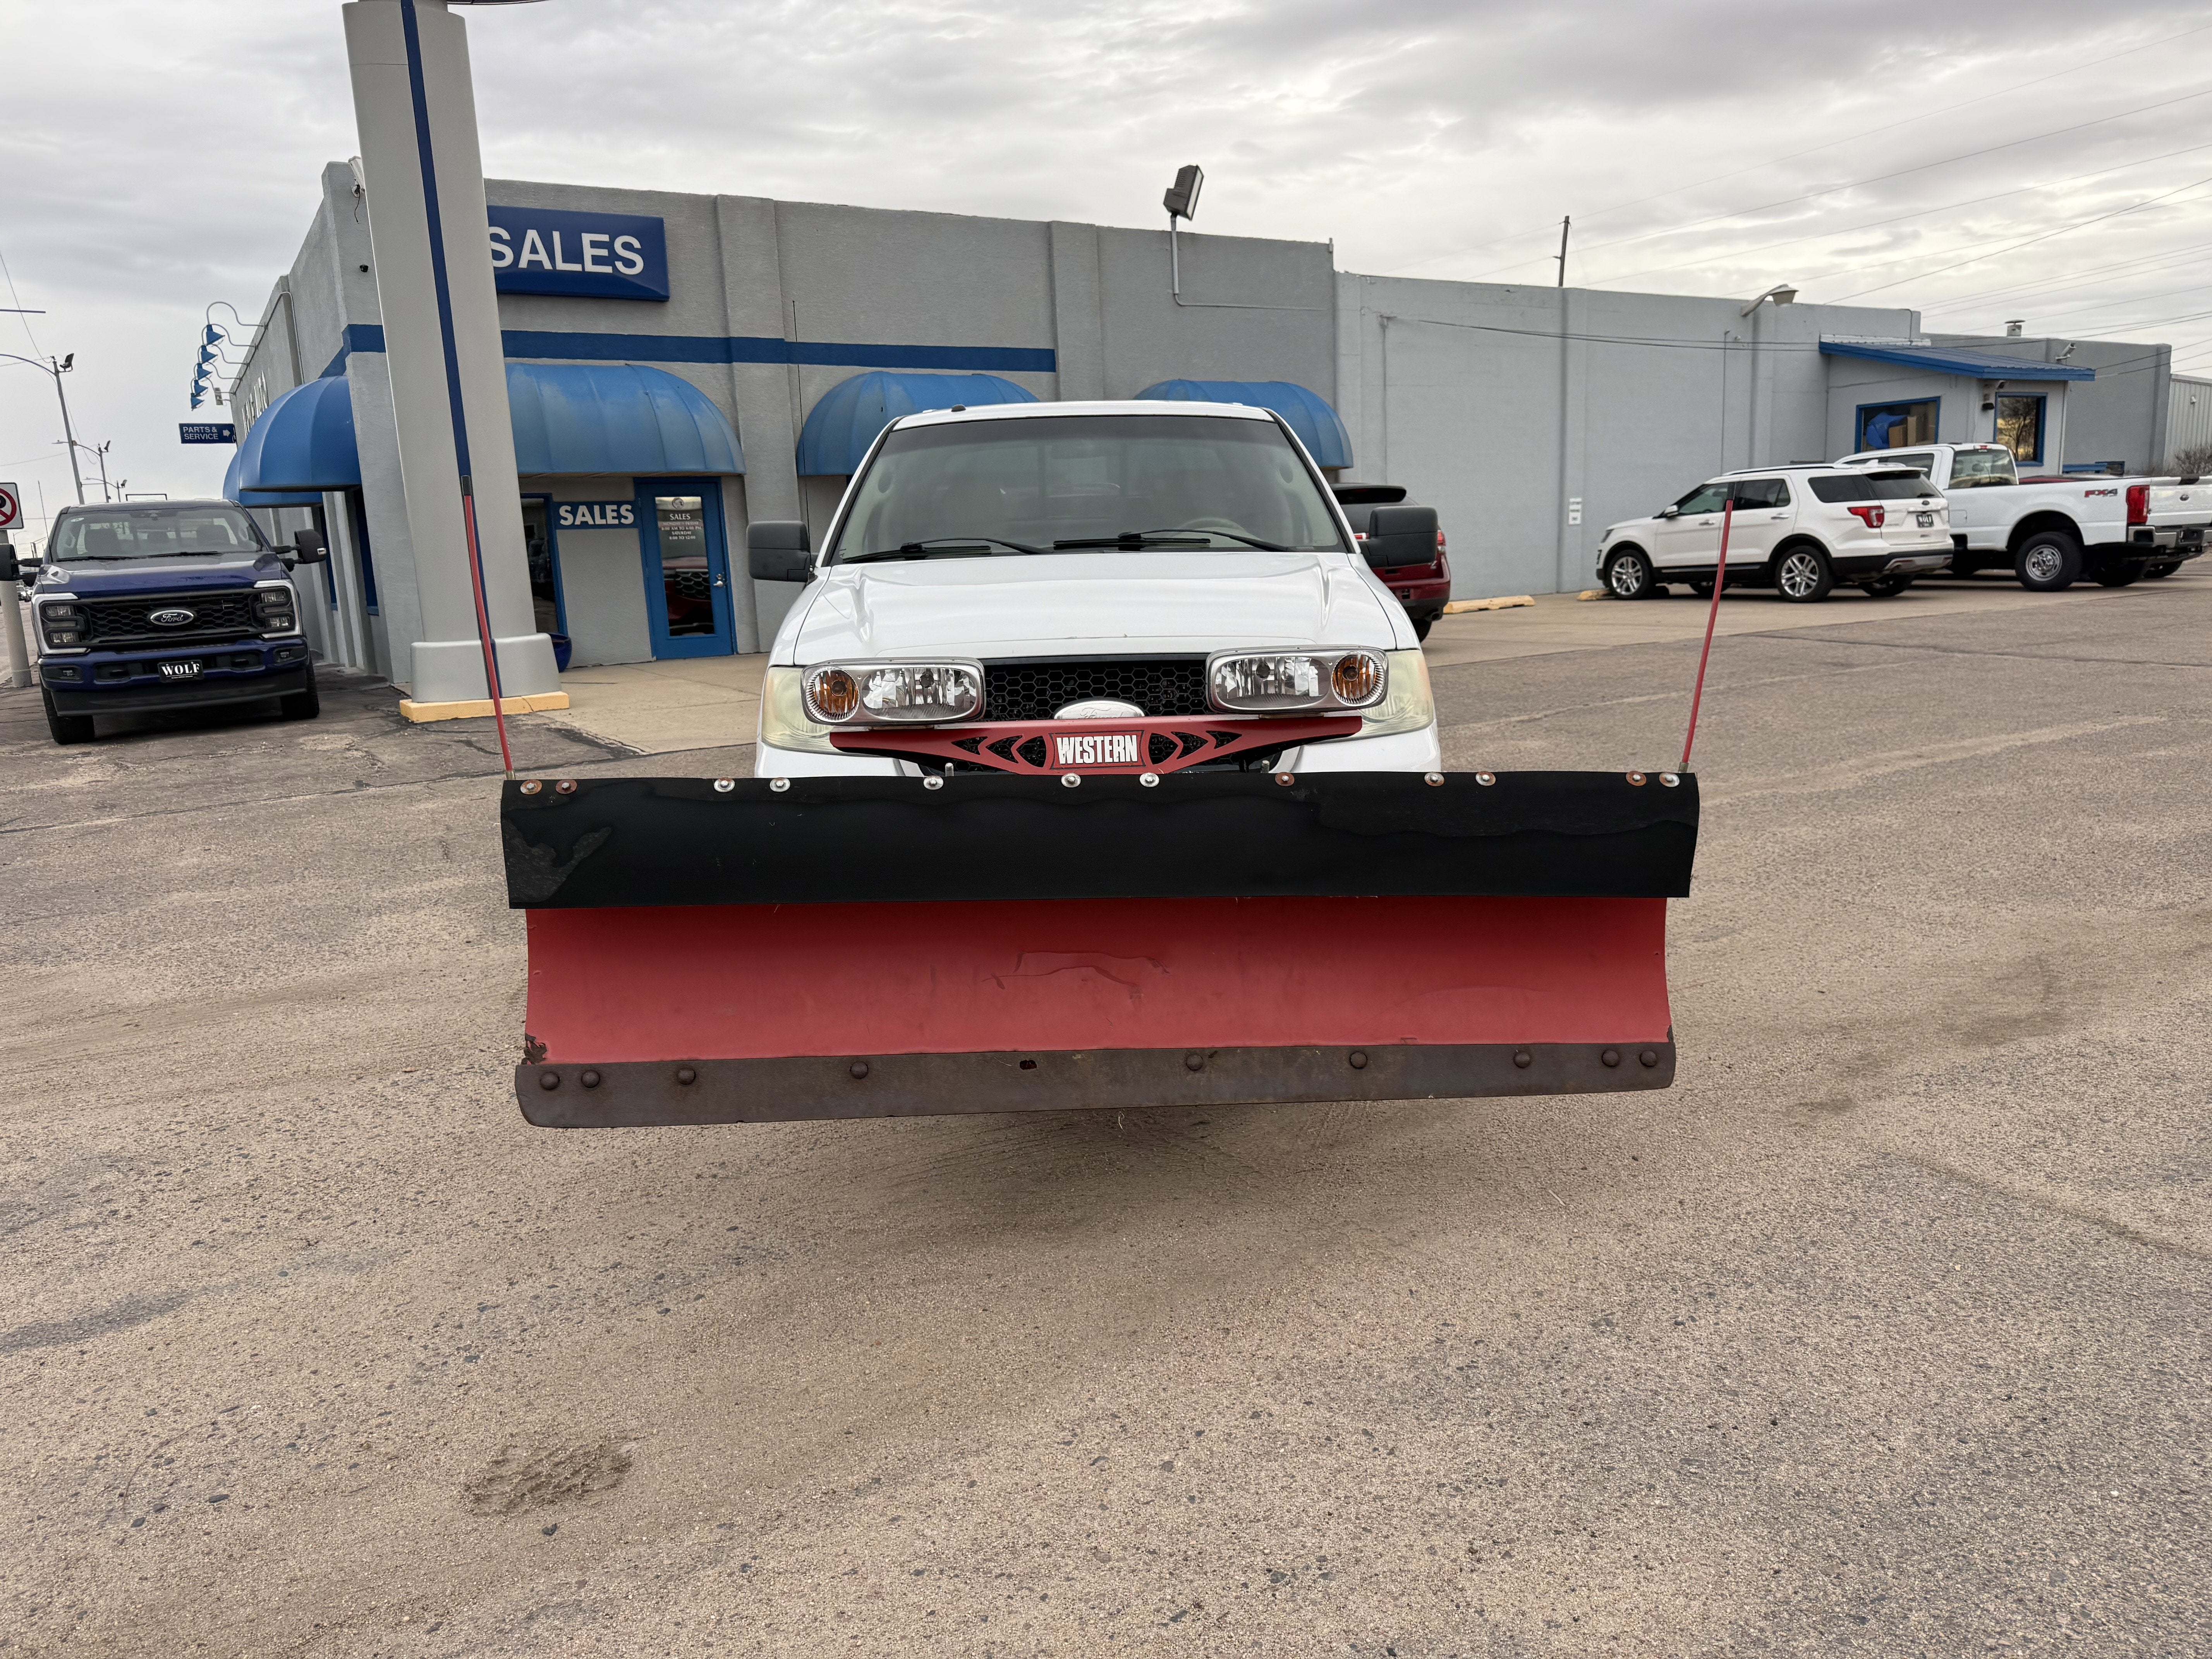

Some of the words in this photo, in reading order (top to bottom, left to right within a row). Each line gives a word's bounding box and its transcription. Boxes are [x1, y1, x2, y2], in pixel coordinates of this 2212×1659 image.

[489, 226, 644, 275] SALES
[2084, 489, 2118, 498] FX4
[559, 504, 634, 526] SALES
[161, 613, 184, 622] Ford
[161, 663, 200, 675] WOLF
[1056, 735, 1138, 764] WESTERN
